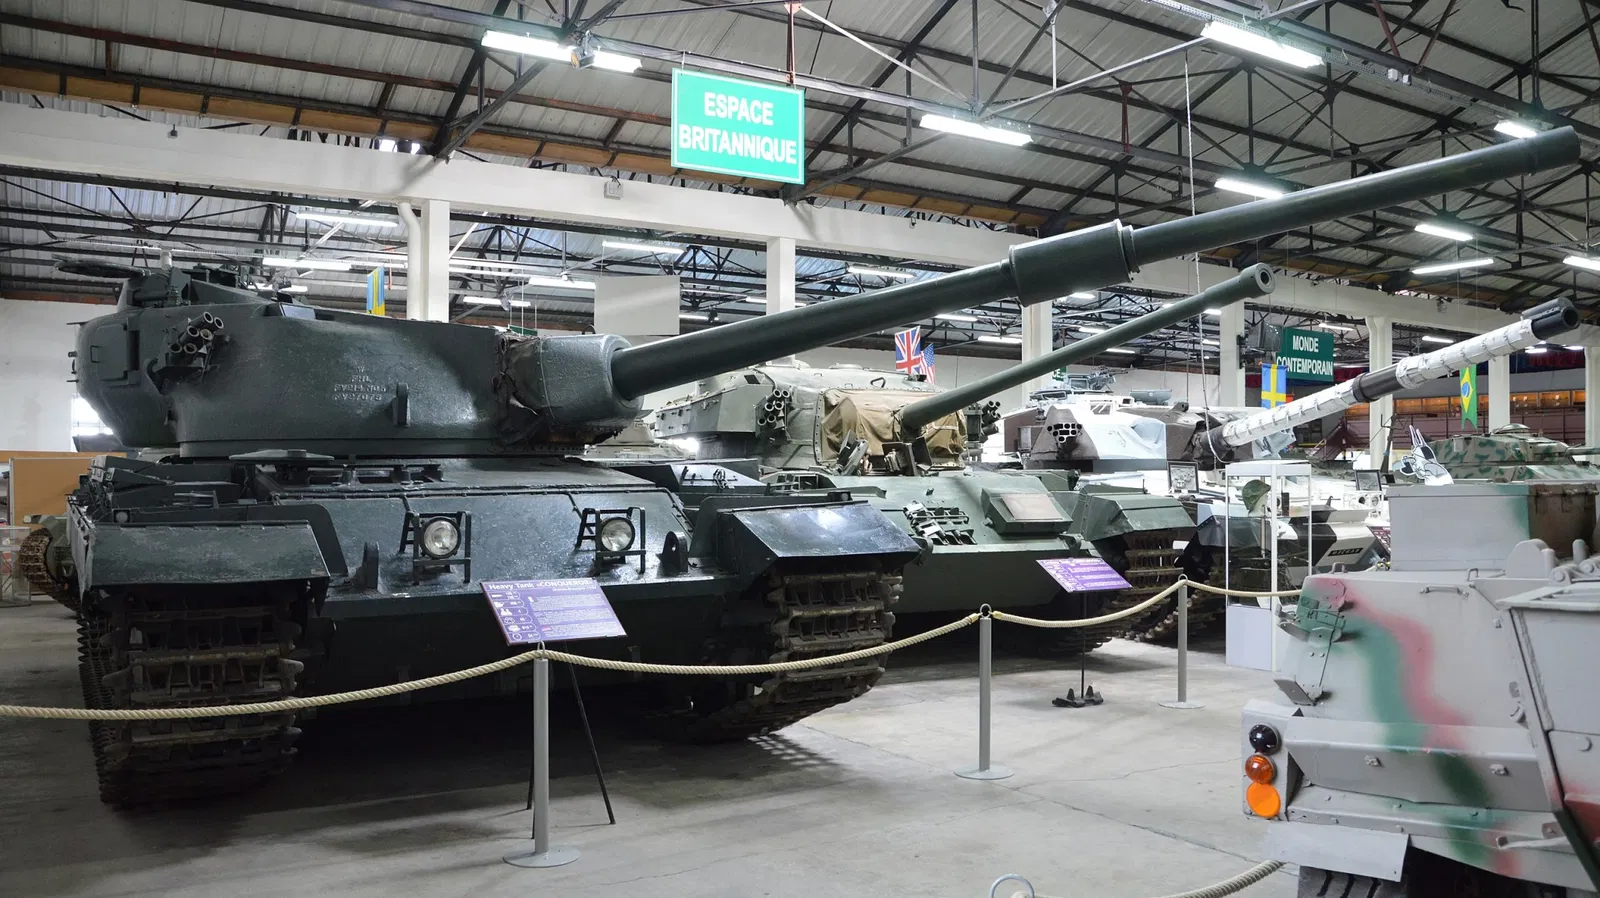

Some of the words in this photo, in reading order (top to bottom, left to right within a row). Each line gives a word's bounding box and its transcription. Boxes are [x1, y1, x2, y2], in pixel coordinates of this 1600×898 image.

[704, 91, 774, 127] ESPACE
[678, 123, 797, 164] BRITANNIQUE
[1292, 335, 1319, 353] MONDE
[1276, 356, 1333, 376] CONTEMPORAIN
[488, 583, 514, 591] Heavy
